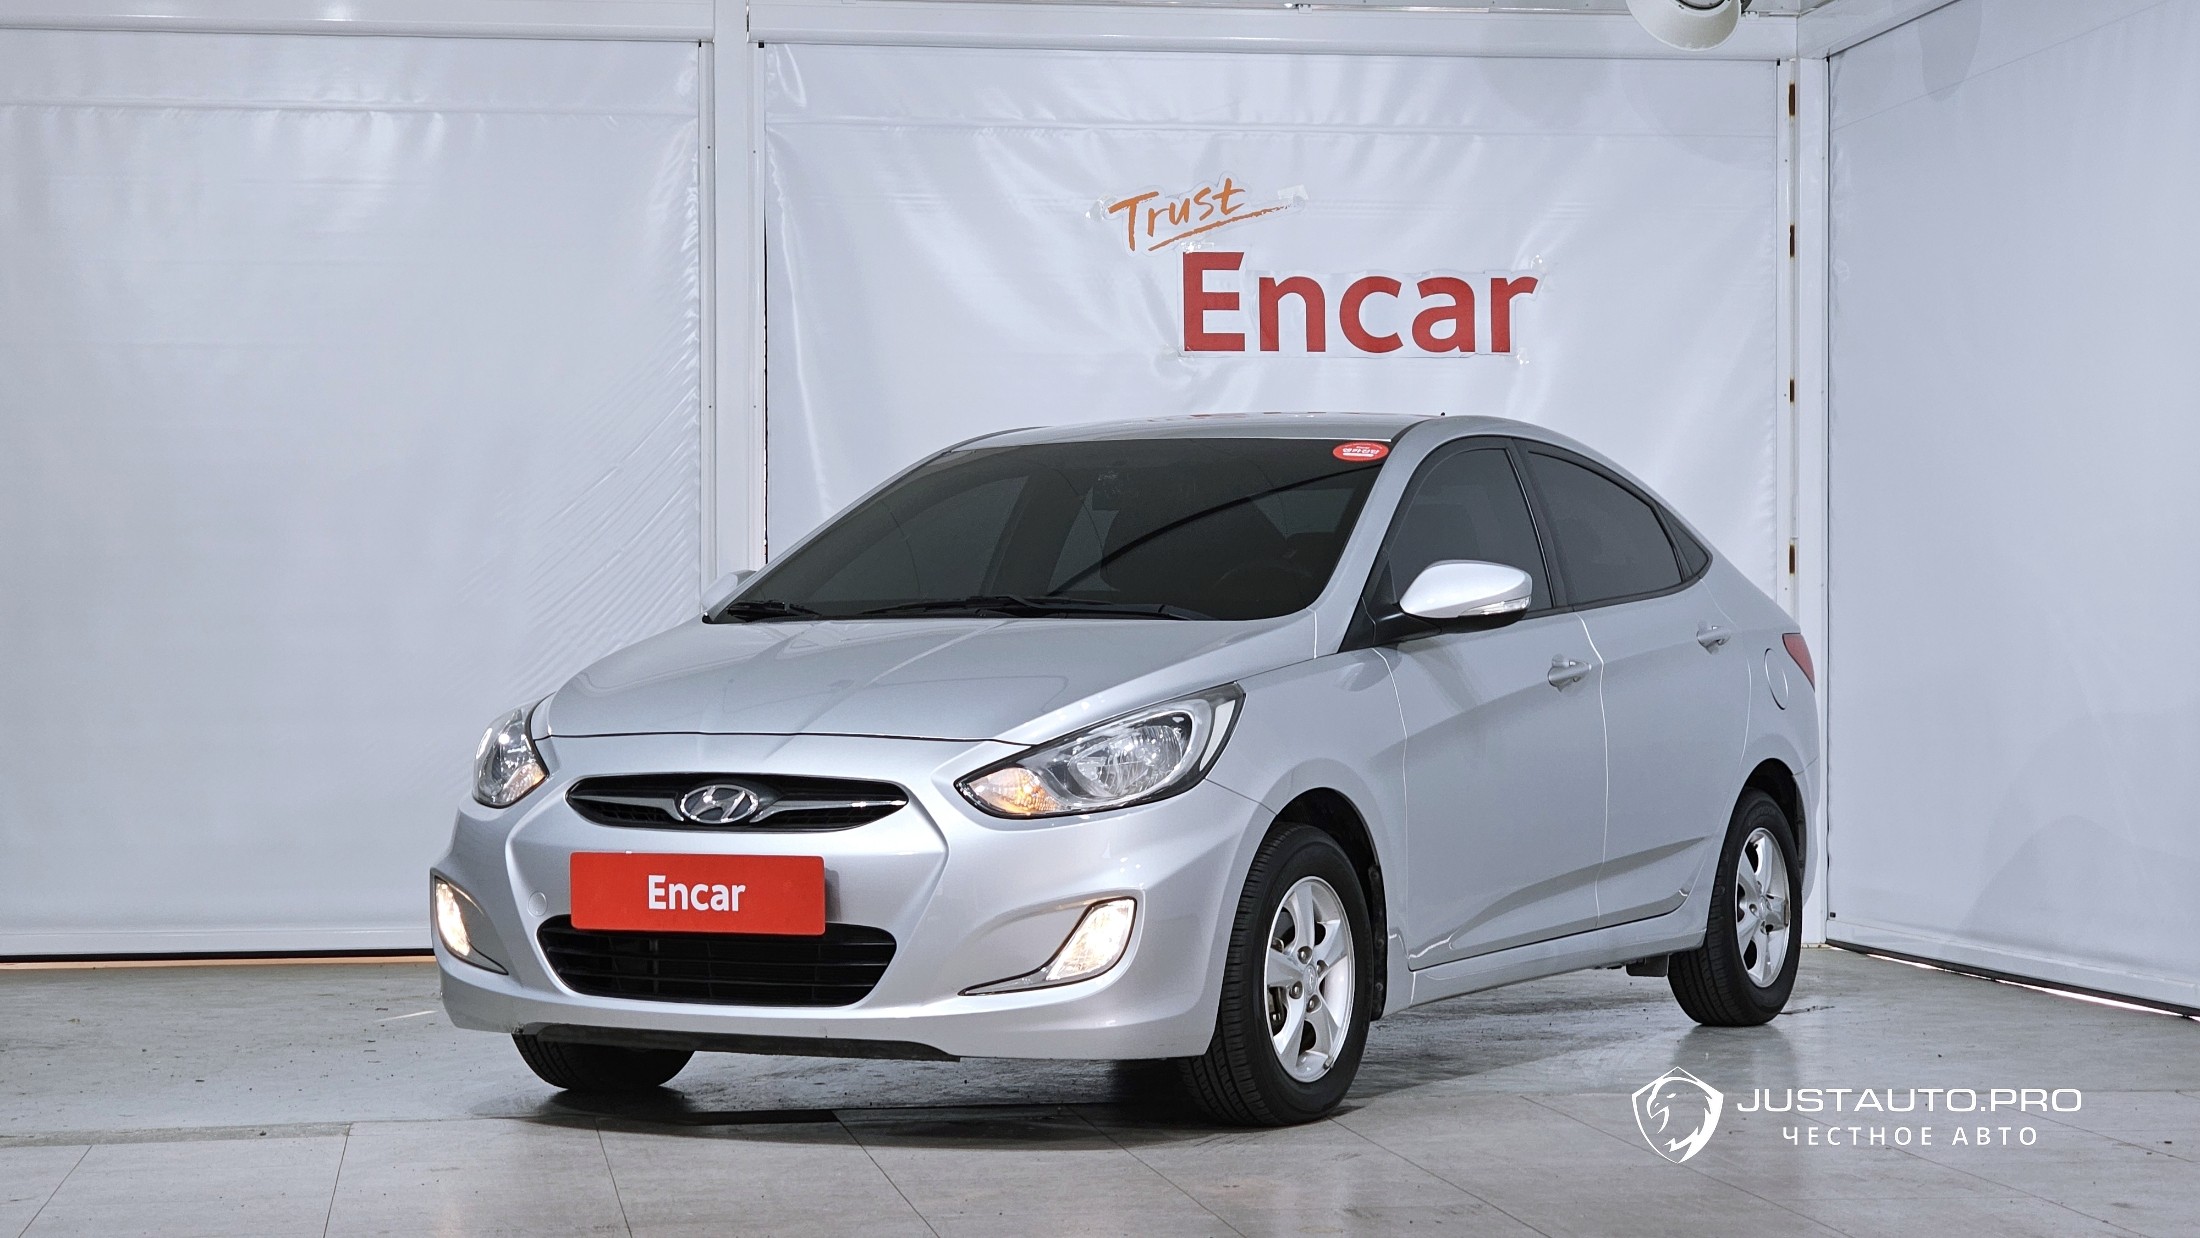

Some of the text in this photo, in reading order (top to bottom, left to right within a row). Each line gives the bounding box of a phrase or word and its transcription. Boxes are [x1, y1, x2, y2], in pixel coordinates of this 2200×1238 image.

[1107, 177, 1247, 252] Trust
[1182, 251, 1539, 353] Encar
[648, 874, 746, 912] Encar
